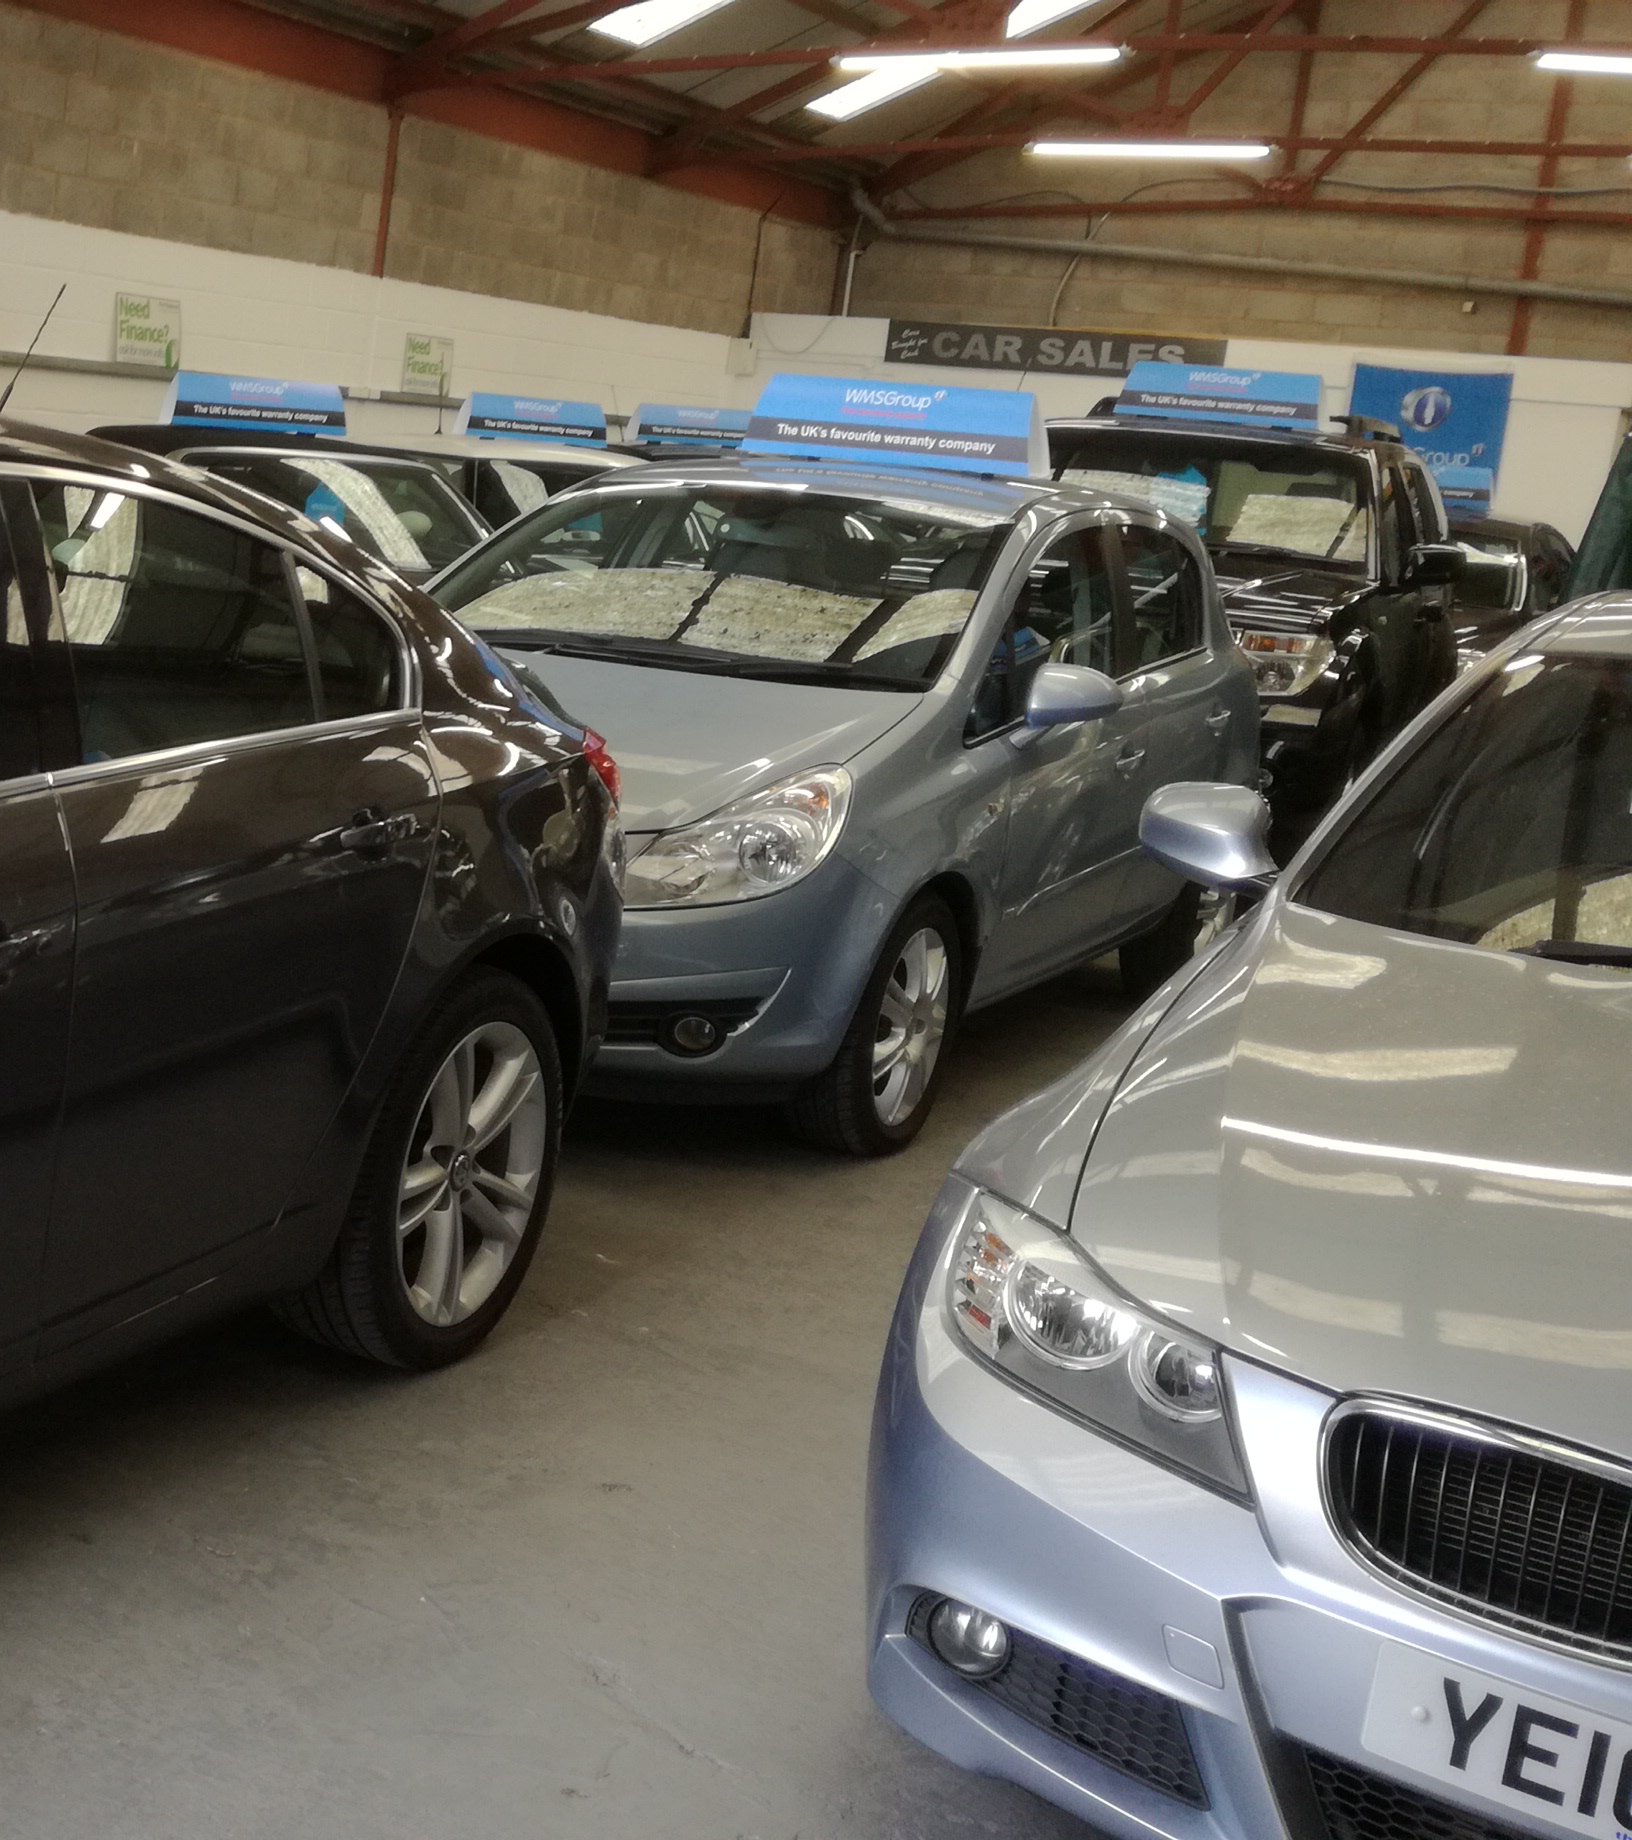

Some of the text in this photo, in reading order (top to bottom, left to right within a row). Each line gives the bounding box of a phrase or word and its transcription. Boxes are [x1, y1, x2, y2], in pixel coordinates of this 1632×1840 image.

[119, 297, 150, 319] Need
[119, 319, 169, 344] Finance?
[407, 337, 431, 356] Need
[932, 331, 1186, 371] CAR SALES
[1188, 371, 1252, 387] WMSGroup
[843, 388, 932, 411] WMSGroup
[1140, 393, 1297, 416] The UK's favourite warranty company
[193, 404, 329, 424] The UK's favourite warranty company
[483, 419, 496, 427] The
[776, 423, 997, 455] The UK's favourite warranty company
